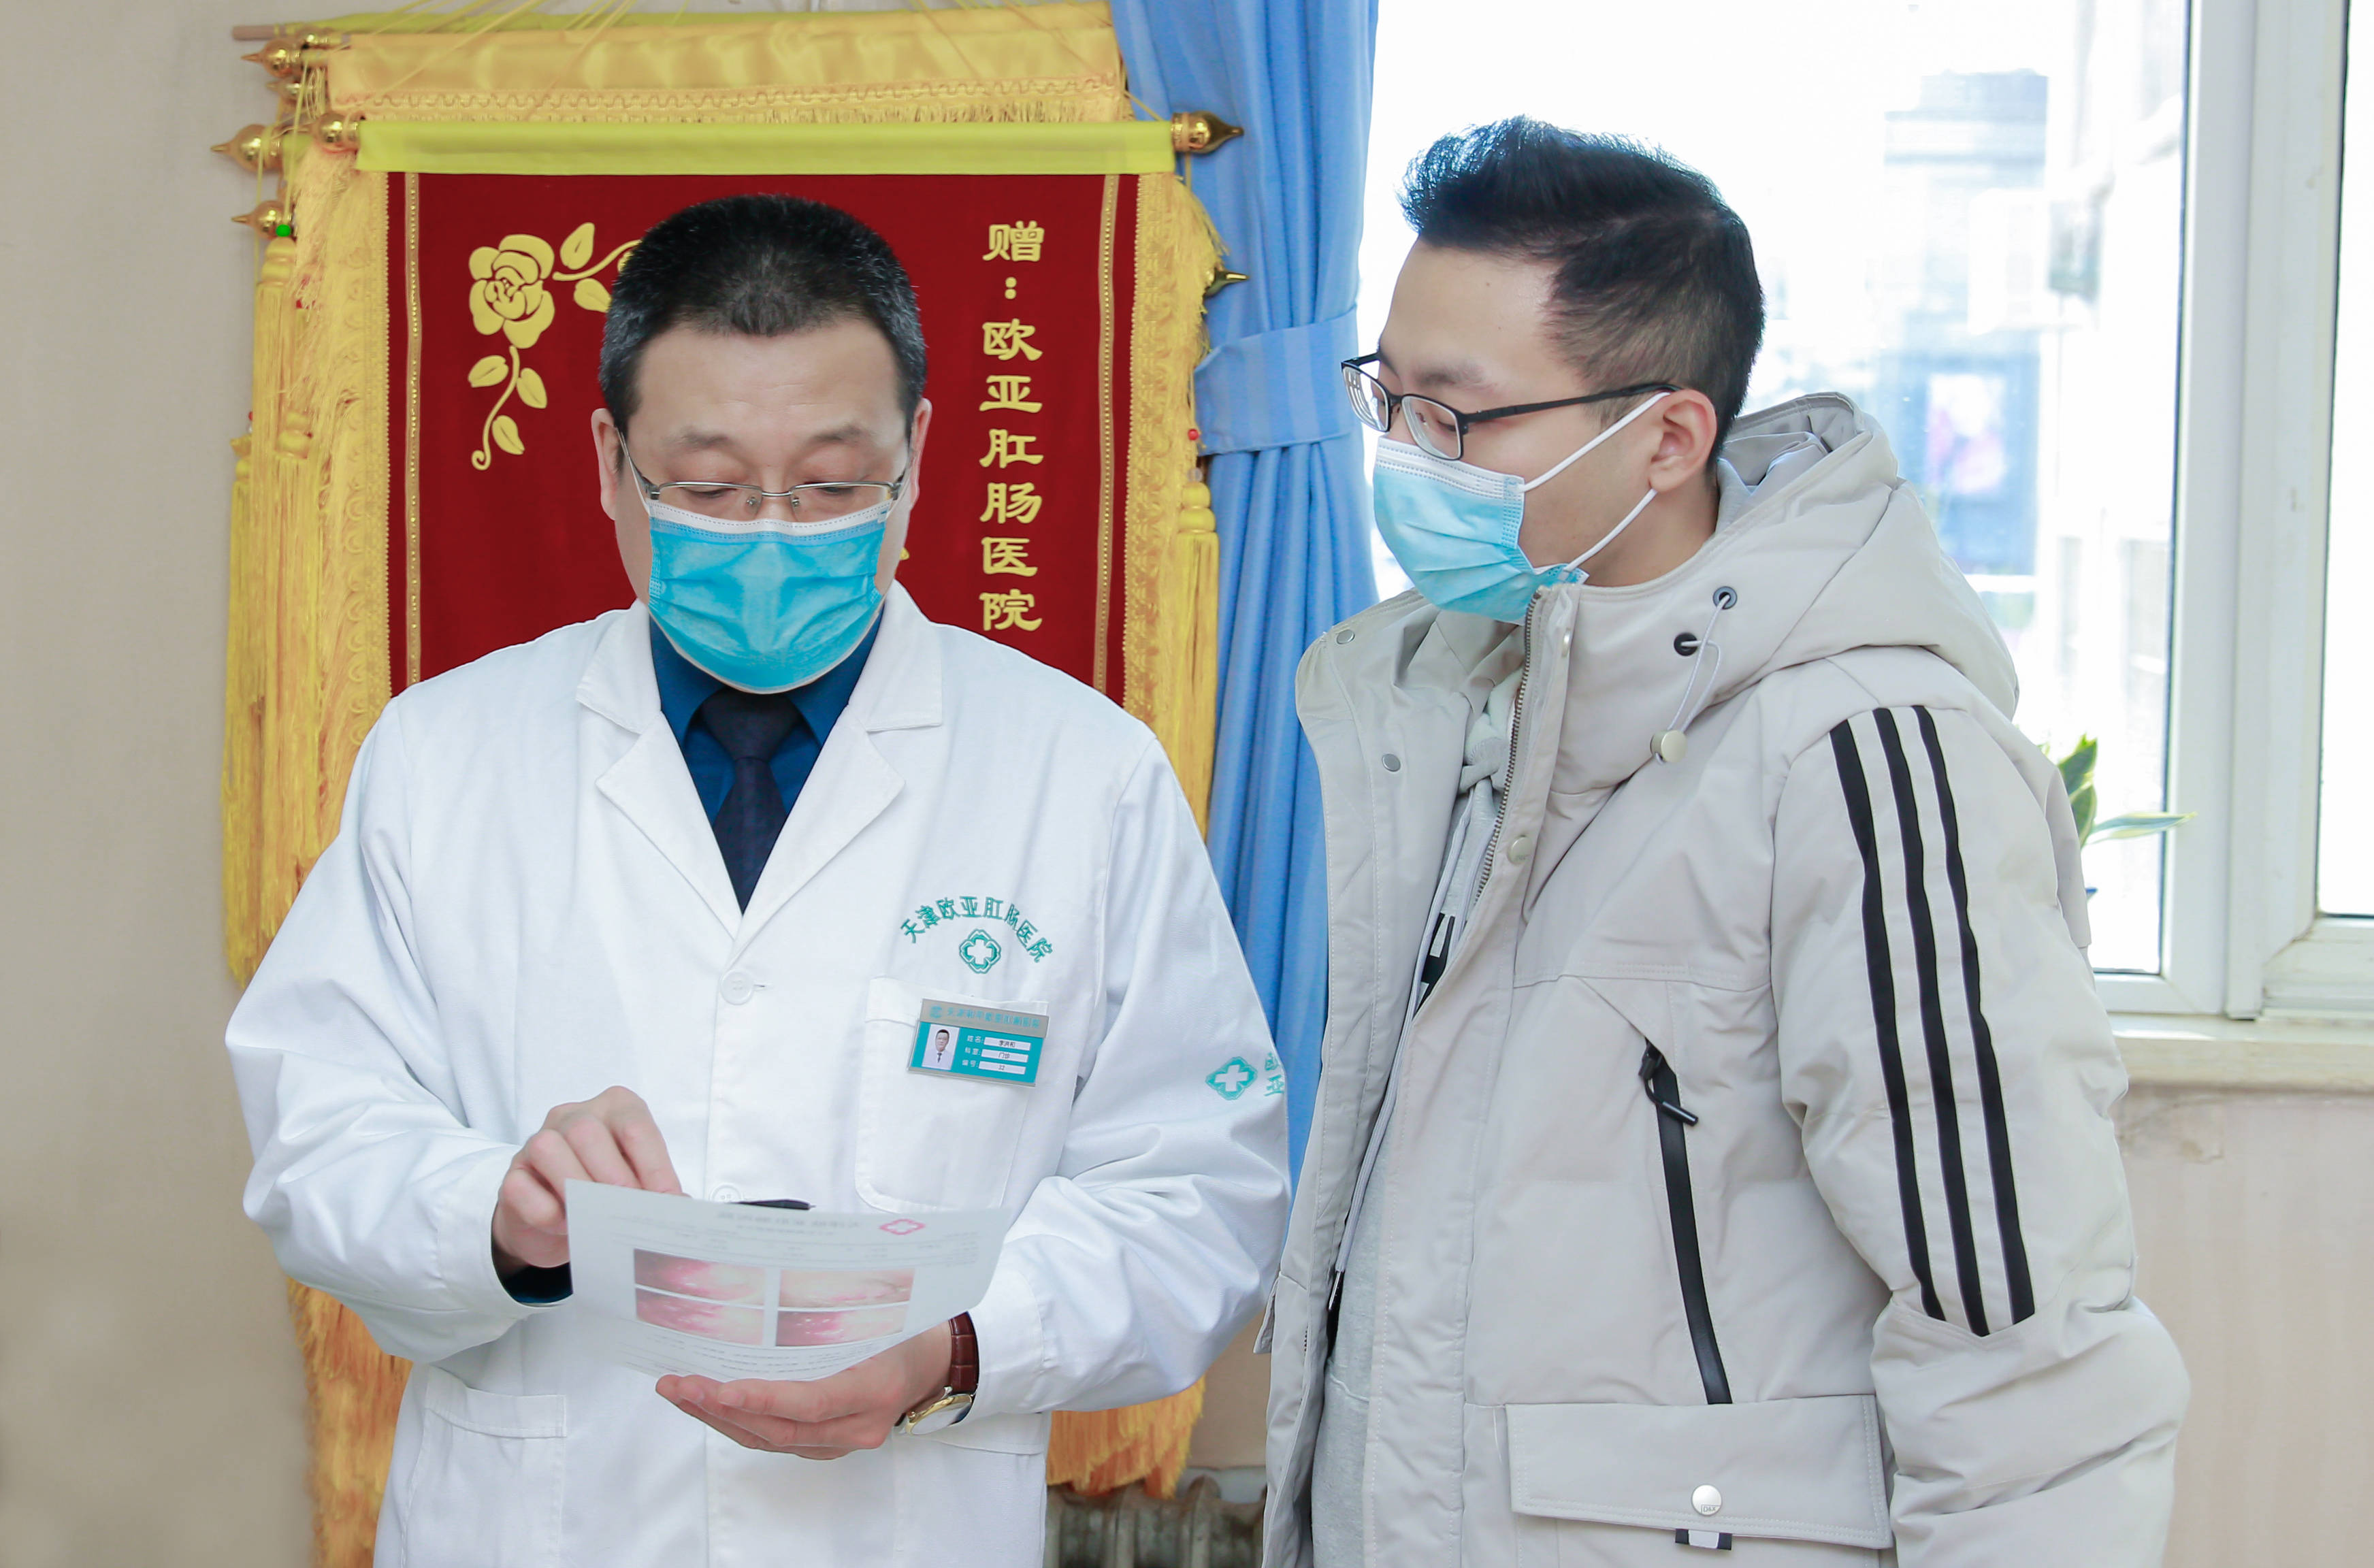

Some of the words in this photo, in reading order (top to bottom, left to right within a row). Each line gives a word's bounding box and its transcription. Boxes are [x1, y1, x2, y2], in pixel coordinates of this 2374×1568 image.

[979, 220, 1045, 632] 赠：欧亚肛肠医院
[900, 896, 1054, 963] 天津欧亚肛肠医院
